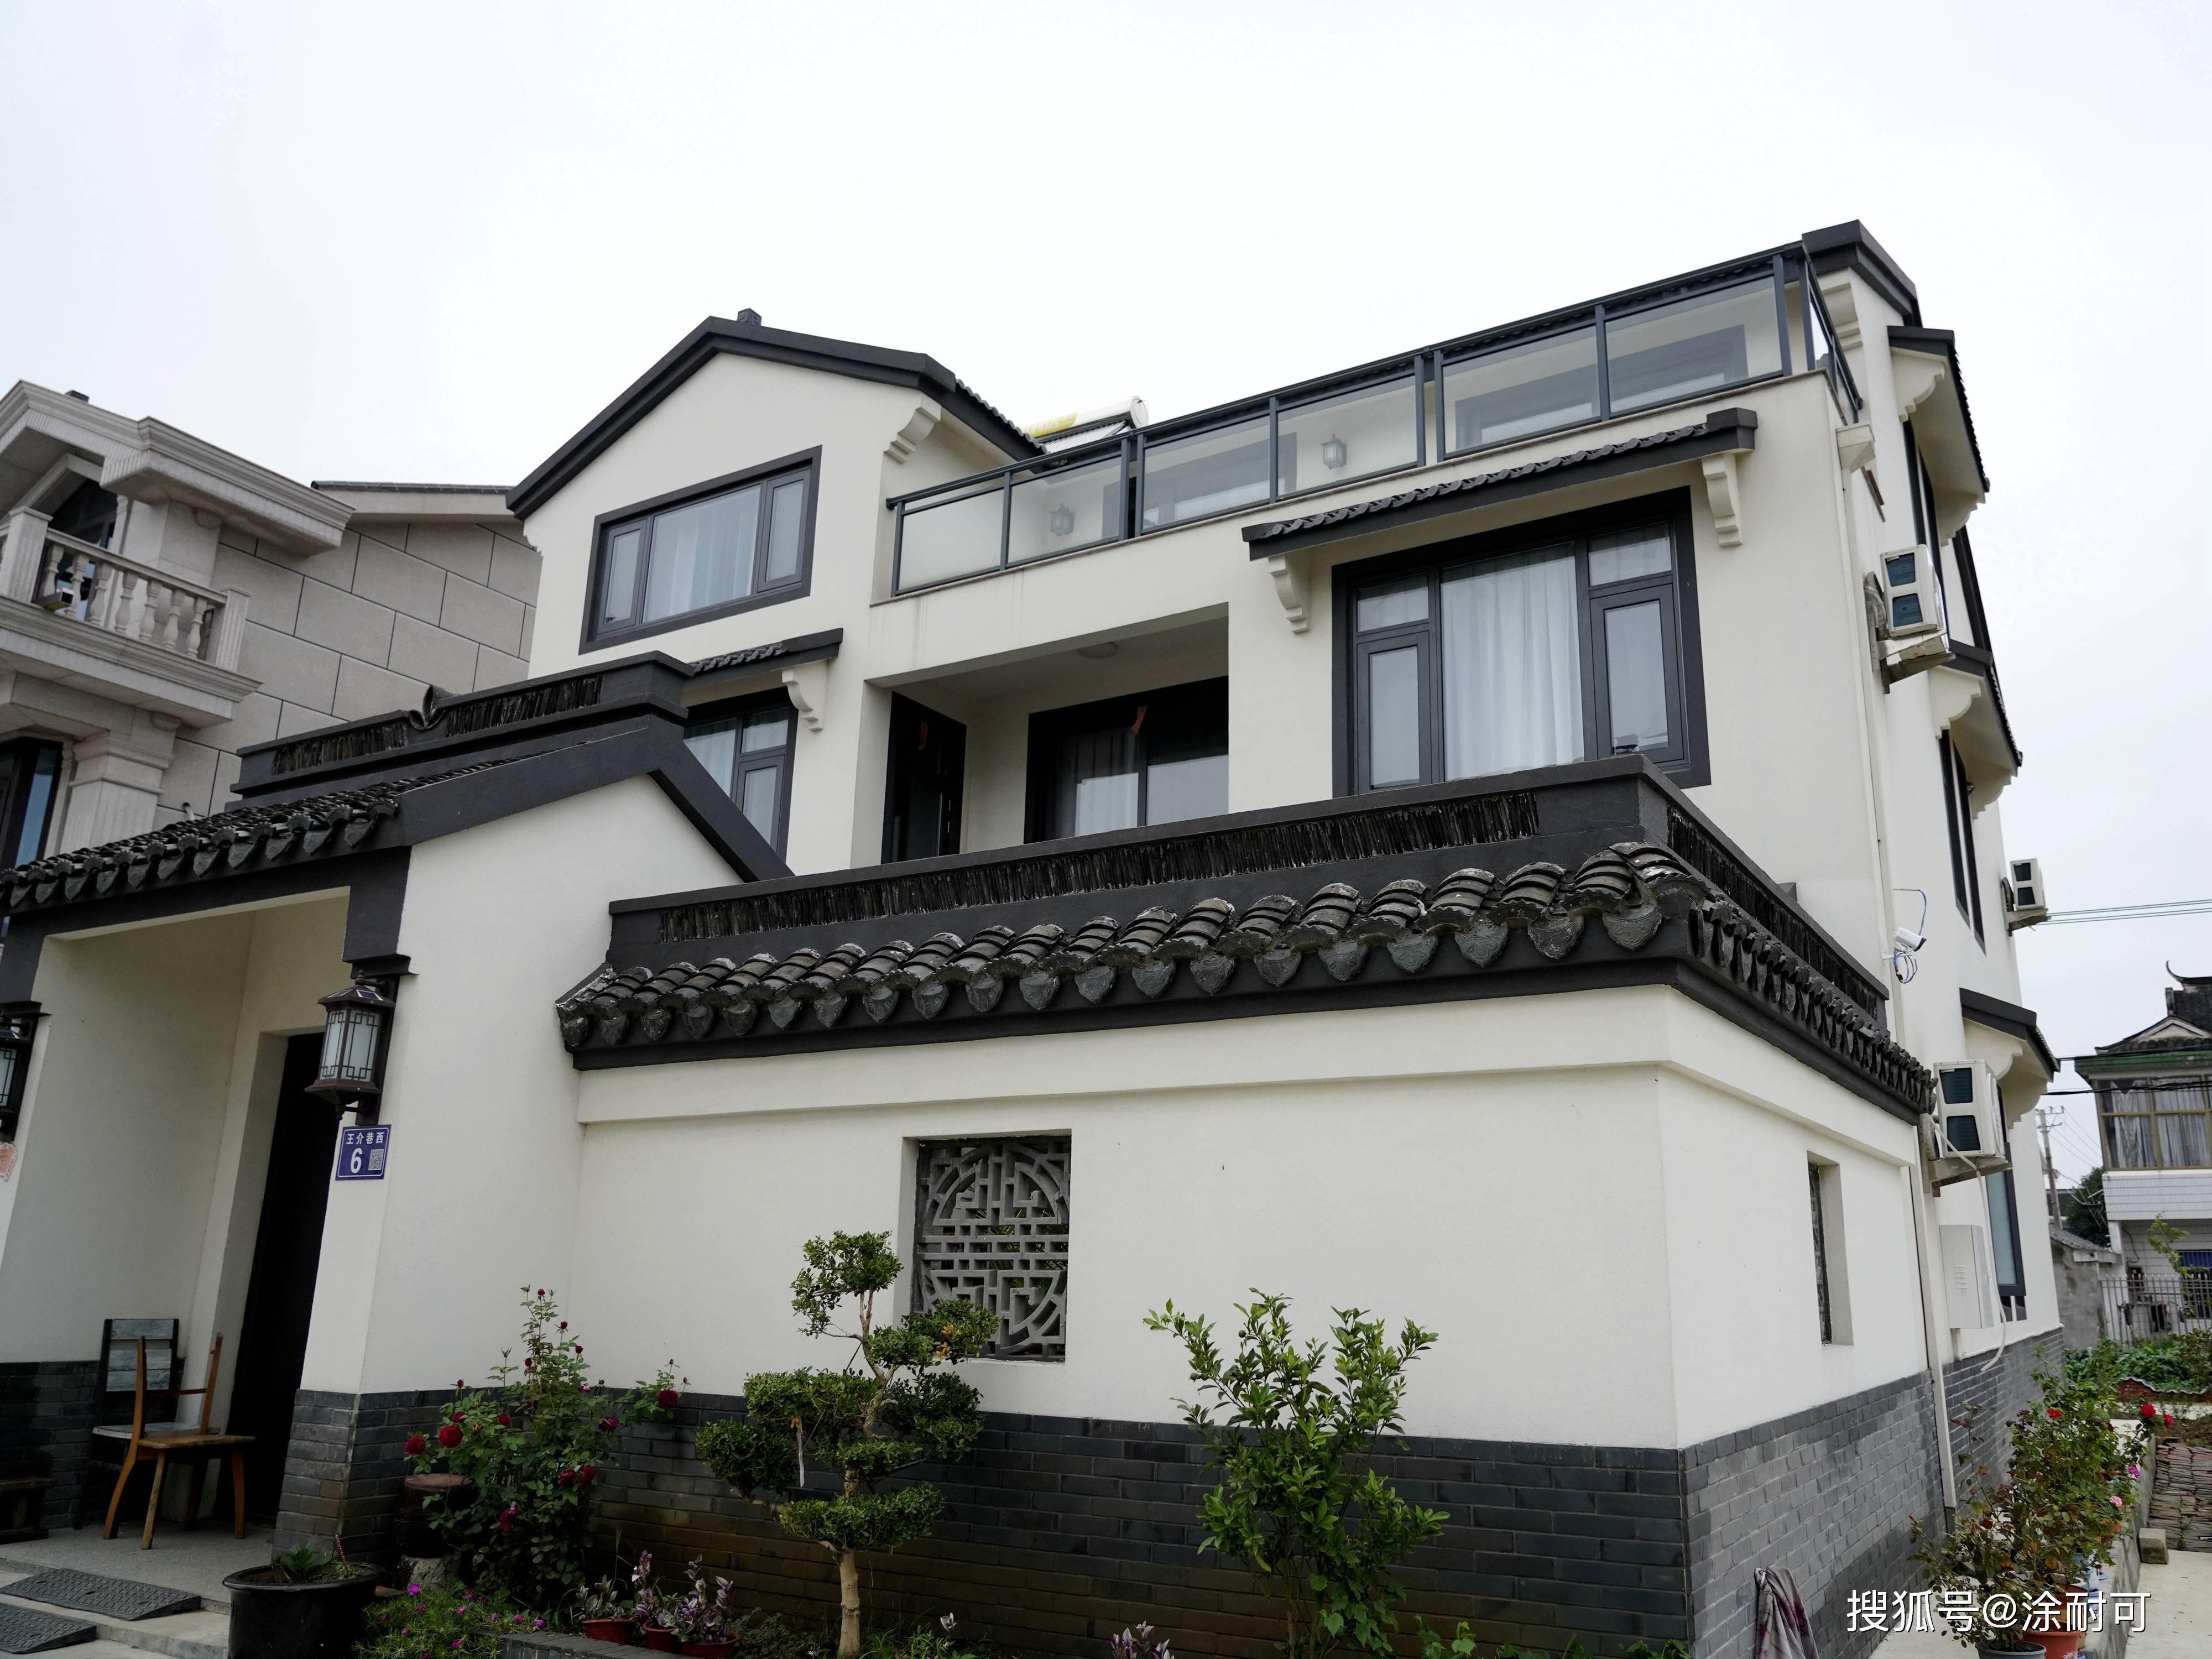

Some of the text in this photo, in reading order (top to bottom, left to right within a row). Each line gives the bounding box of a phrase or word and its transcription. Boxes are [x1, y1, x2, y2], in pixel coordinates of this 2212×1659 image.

[346, 1132, 384, 1144] 王介巷西
[351, 1147, 363, 1173] 6
